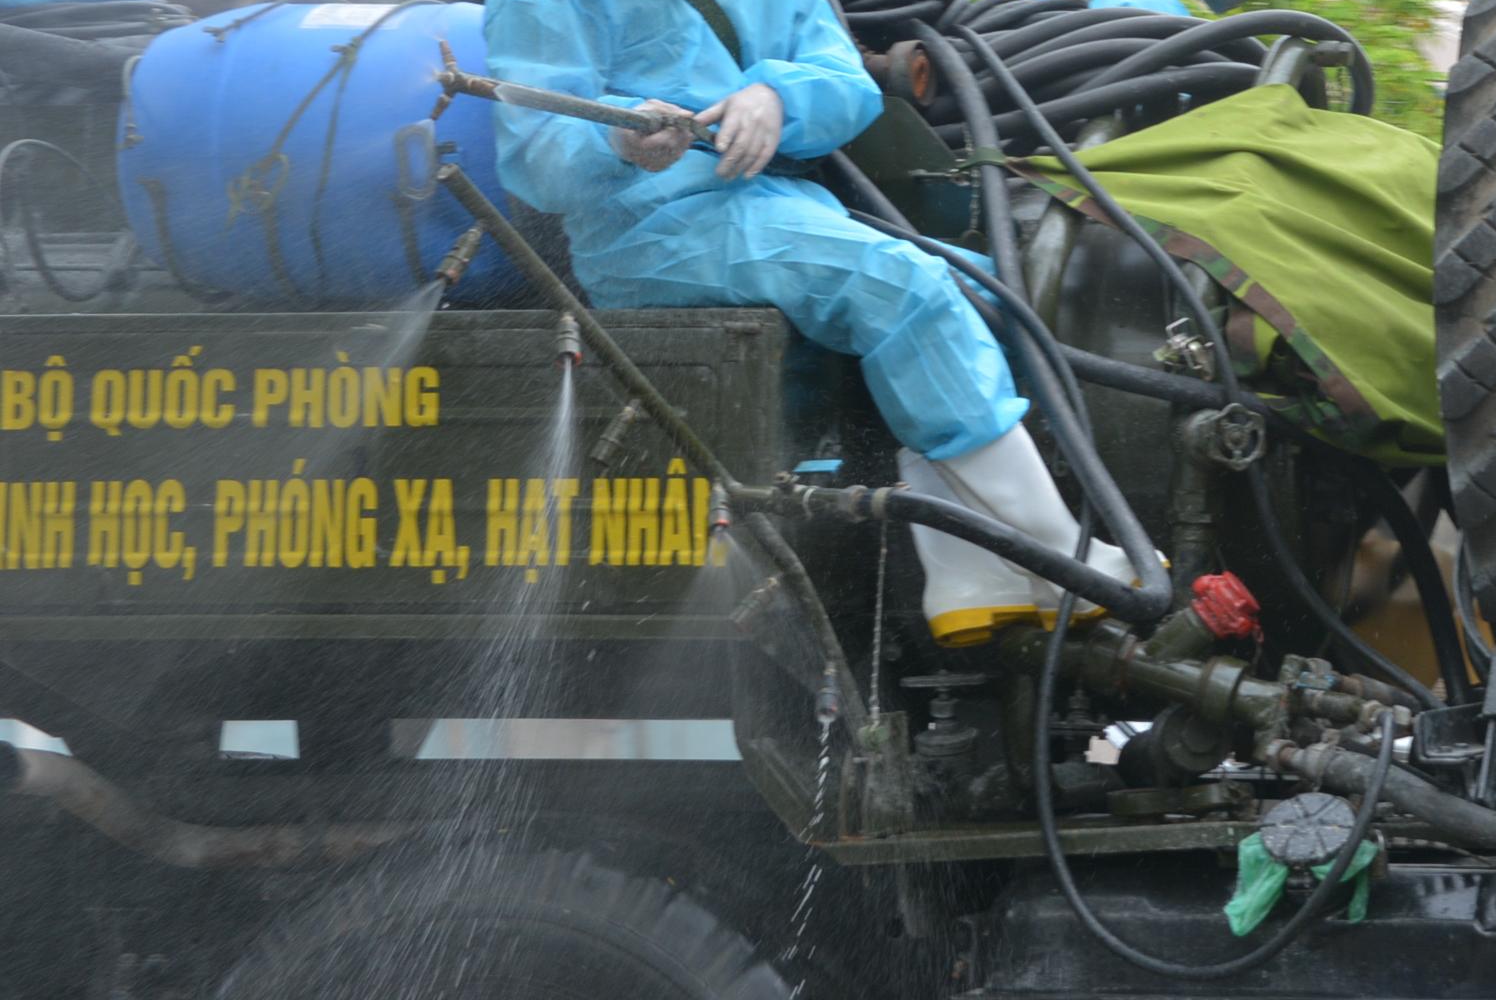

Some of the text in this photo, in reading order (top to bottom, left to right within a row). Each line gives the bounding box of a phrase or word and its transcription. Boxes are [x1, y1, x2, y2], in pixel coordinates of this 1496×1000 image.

[1, 346, 439, 441] BỘ QUỐC PHÒNG
[88, 479, 196, 586] HỌC,
[213, 458, 378, 568] PHÓNG
[389, 478, 470, 584] XẠ,
[485, 478, 579, 584] HẠT
